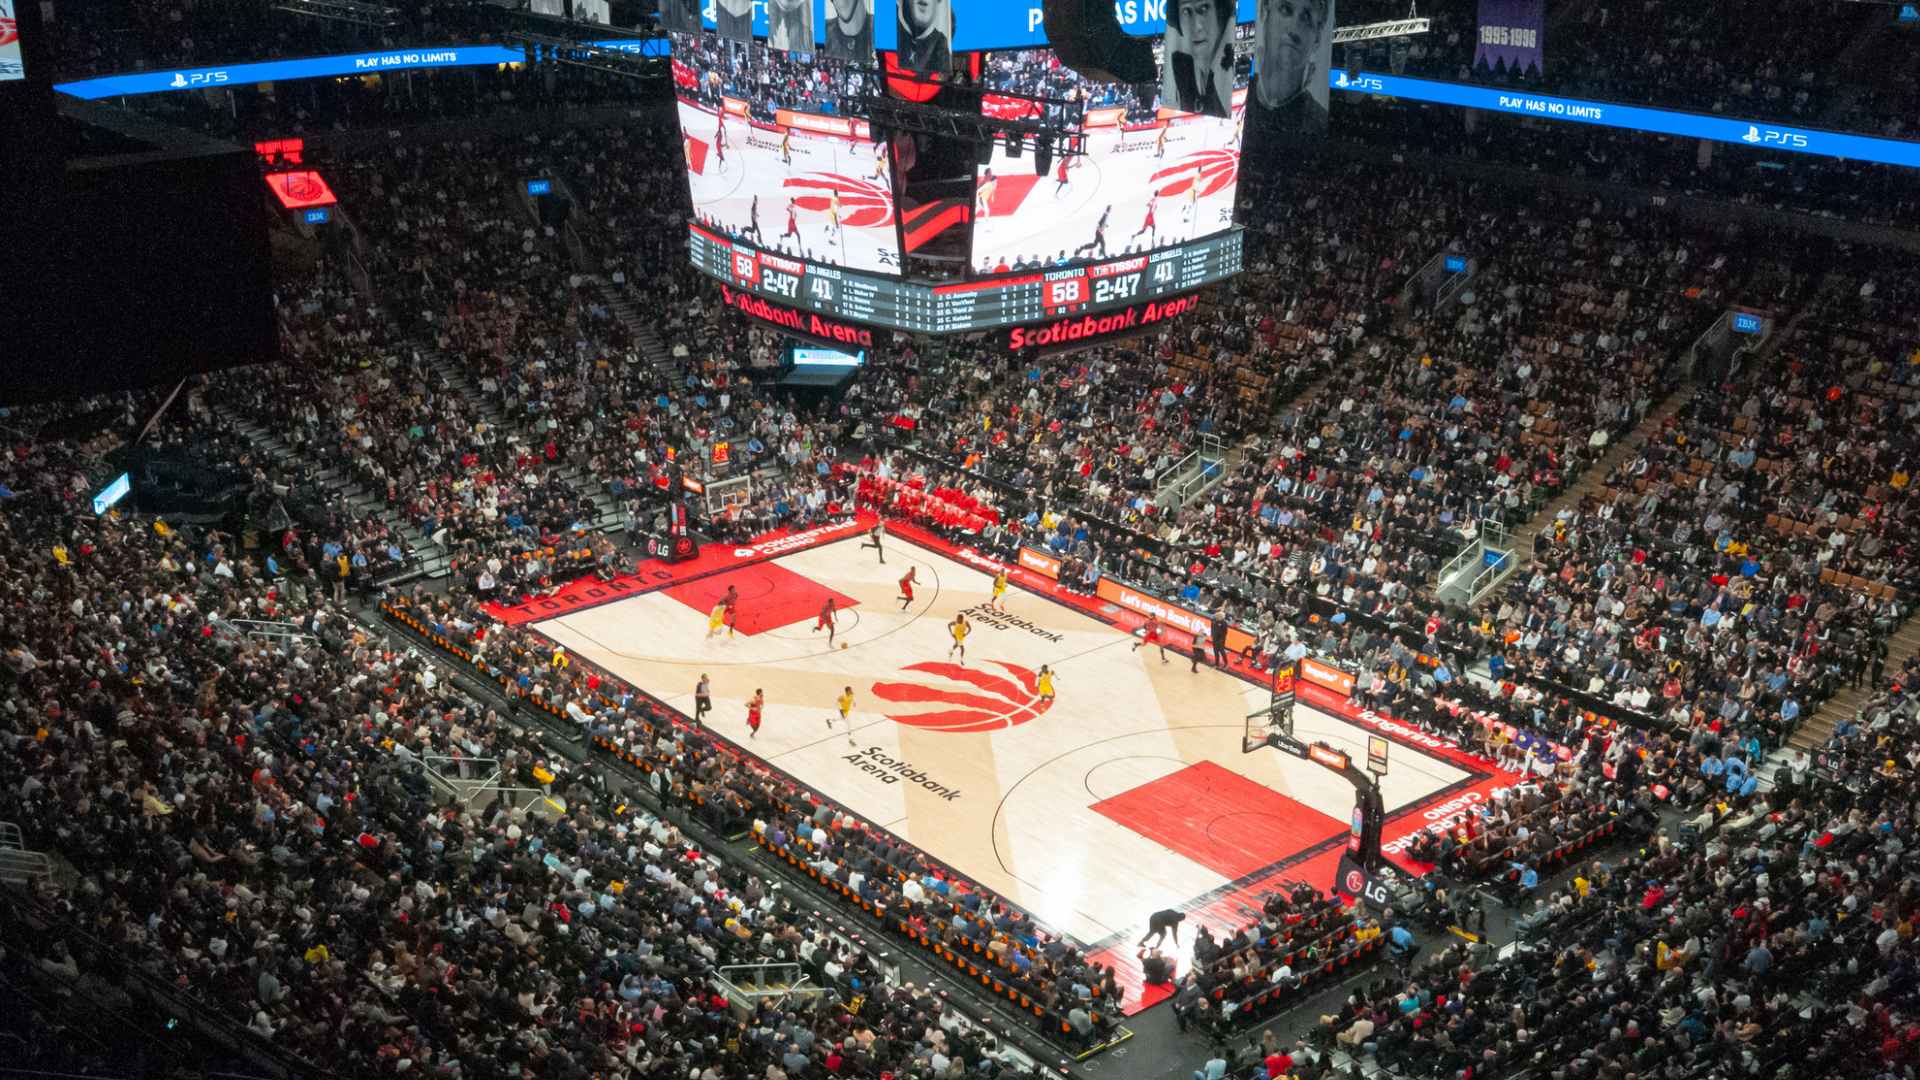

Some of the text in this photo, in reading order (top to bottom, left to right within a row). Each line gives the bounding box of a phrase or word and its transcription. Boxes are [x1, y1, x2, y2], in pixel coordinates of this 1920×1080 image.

[356, 52, 457, 68] PLAY HAS NO LIMITS
[191, 72, 228, 84] PS5
[1351, 77, 1382, 90] PS5
[1500, 96, 1601, 119] PLAY HAS NO LIMITS
[1764, 130, 1808, 147] PS5
[735, 255, 753, 278] 58
[1045, 267, 1085, 282] TORONTO
[1110, 257, 1145, 274] TISSOT
[1154, 262, 1173, 283] 41
[763, 269, 799, 298] 2:47
[811, 277, 833, 300] 41
[1052, 281, 1079, 304] 58
[1095, 273, 1141, 302] 2:47
[811, 313, 872, 348] Arena
[1008, 295, 1200, 350] Scotiabank Arena
[657, 543, 669, 557] LG
[516, 569, 673, 615] TORONTO
[959, 608, 1010, 630] Arena
[974, 602, 1064, 643] Scotiabank
[841, 753, 900, 784] Arena
[860, 746, 961, 801] Scotiabank
[1424, 791, 1482, 820] CASINO
[1364, 881, 1388, 904] LG
